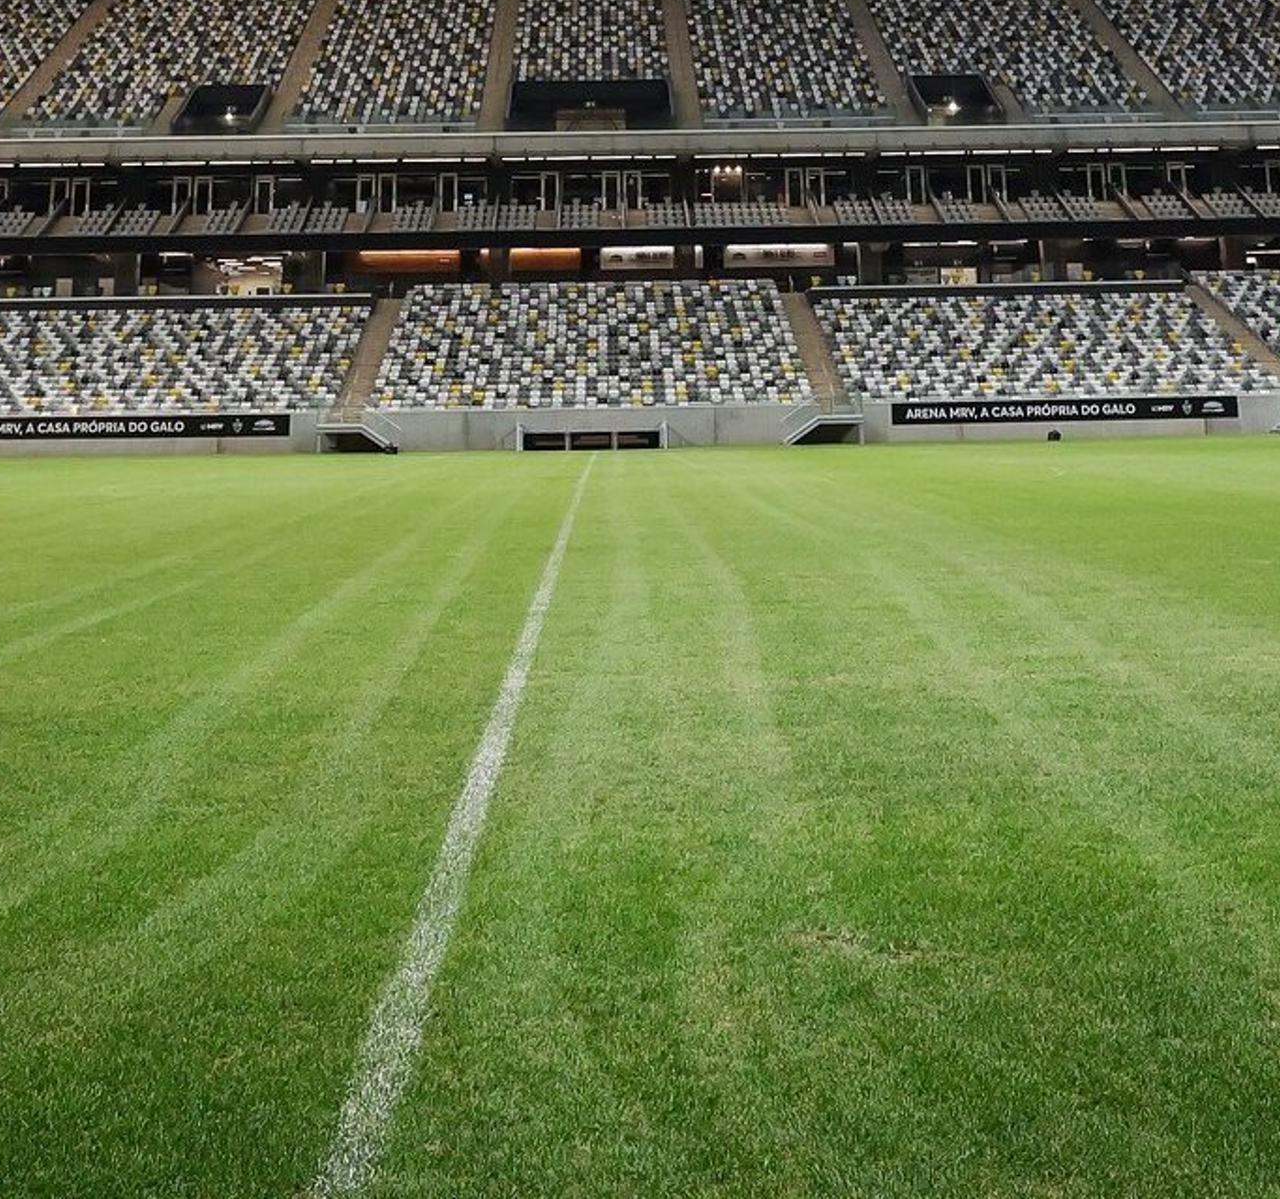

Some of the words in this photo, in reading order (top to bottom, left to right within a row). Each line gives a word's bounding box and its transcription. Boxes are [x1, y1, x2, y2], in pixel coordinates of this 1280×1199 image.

[905, 408, 947, 420] ARENA
[949, 407, 978, 419] MRV,
[980, 406, 990, 418] A
[991, 406, 1024, 418] CASA
[1026, 403, 1079, 417] PRÓPRIA
[1081, 404, 1100, 416] DO
[1102, 403, 1136, 415] GALO
[25, 422, 35, 434] A
[37, 422, 70, 434] CASA
[72, 419, 126, 433] PRÓPRIA
[128, 421, 148, 433] DO
[150, 421, 185, 432] GALO
